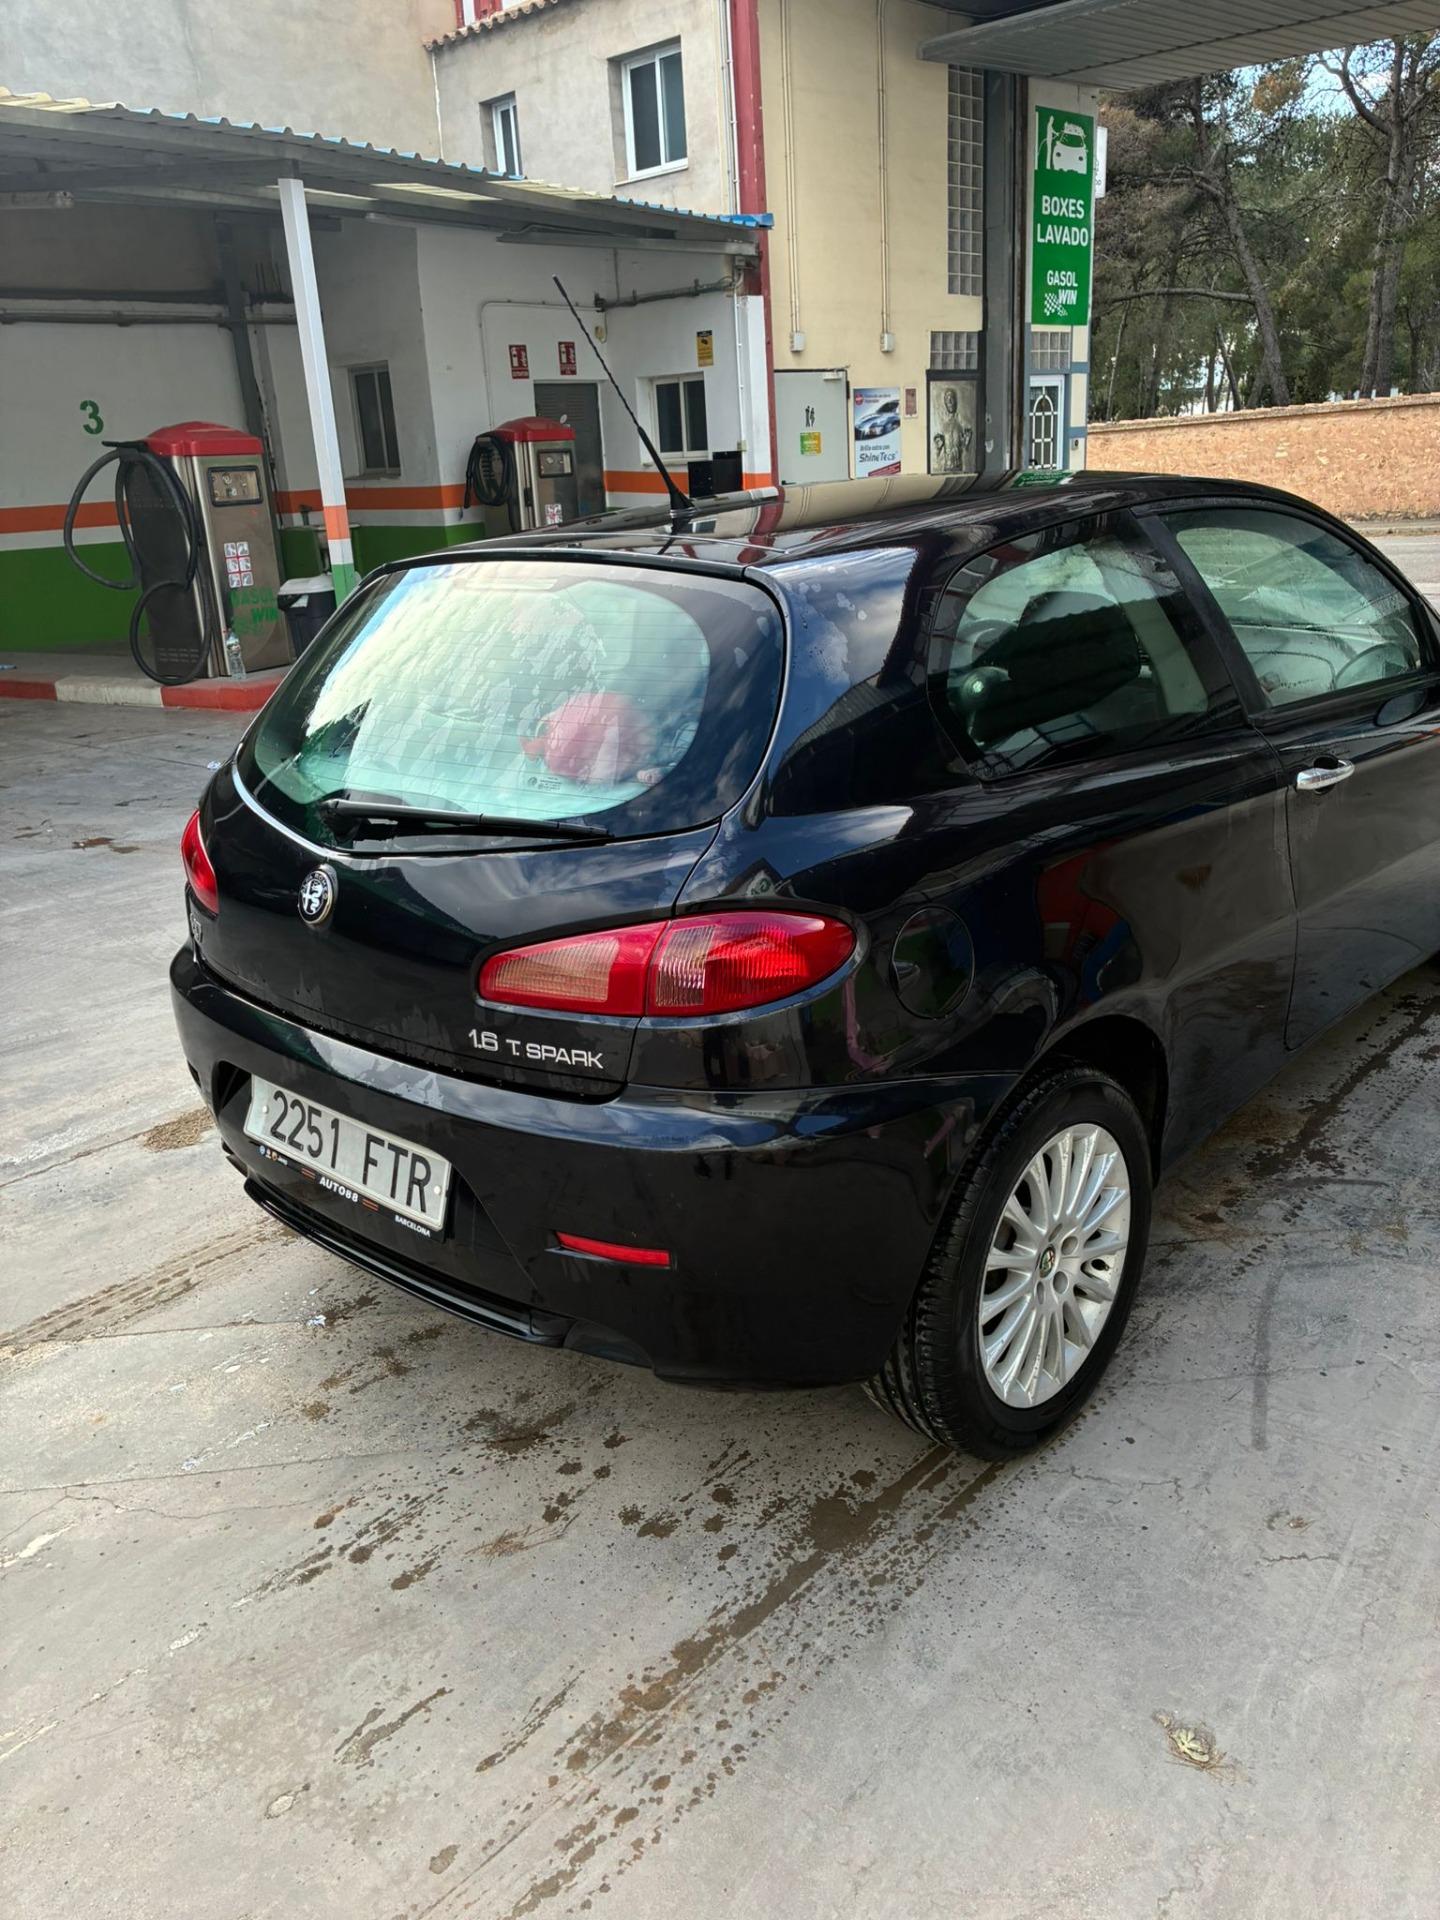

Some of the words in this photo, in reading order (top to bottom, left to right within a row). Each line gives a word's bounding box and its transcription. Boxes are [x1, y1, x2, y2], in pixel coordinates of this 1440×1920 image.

[1042, 195, 1085, 219] BOXES
[1037, 223, 1088, 247] LAVADO
[1047, 270, 1078, 287] GASOL
[1058, 289, 1077, 305] WIN
[79, 400, 104, 435] 3
[468, 1028, 498, 1052] 1.6
[526, 1043, 604, 1069] SPARK
[270, 1090, 340, 1169] 2251
[362, 1133, 432, 1213] FTR
[319, 1176, 359, 1203] AUTO88
[395, 1215, 431, 1238] BARCELONA
